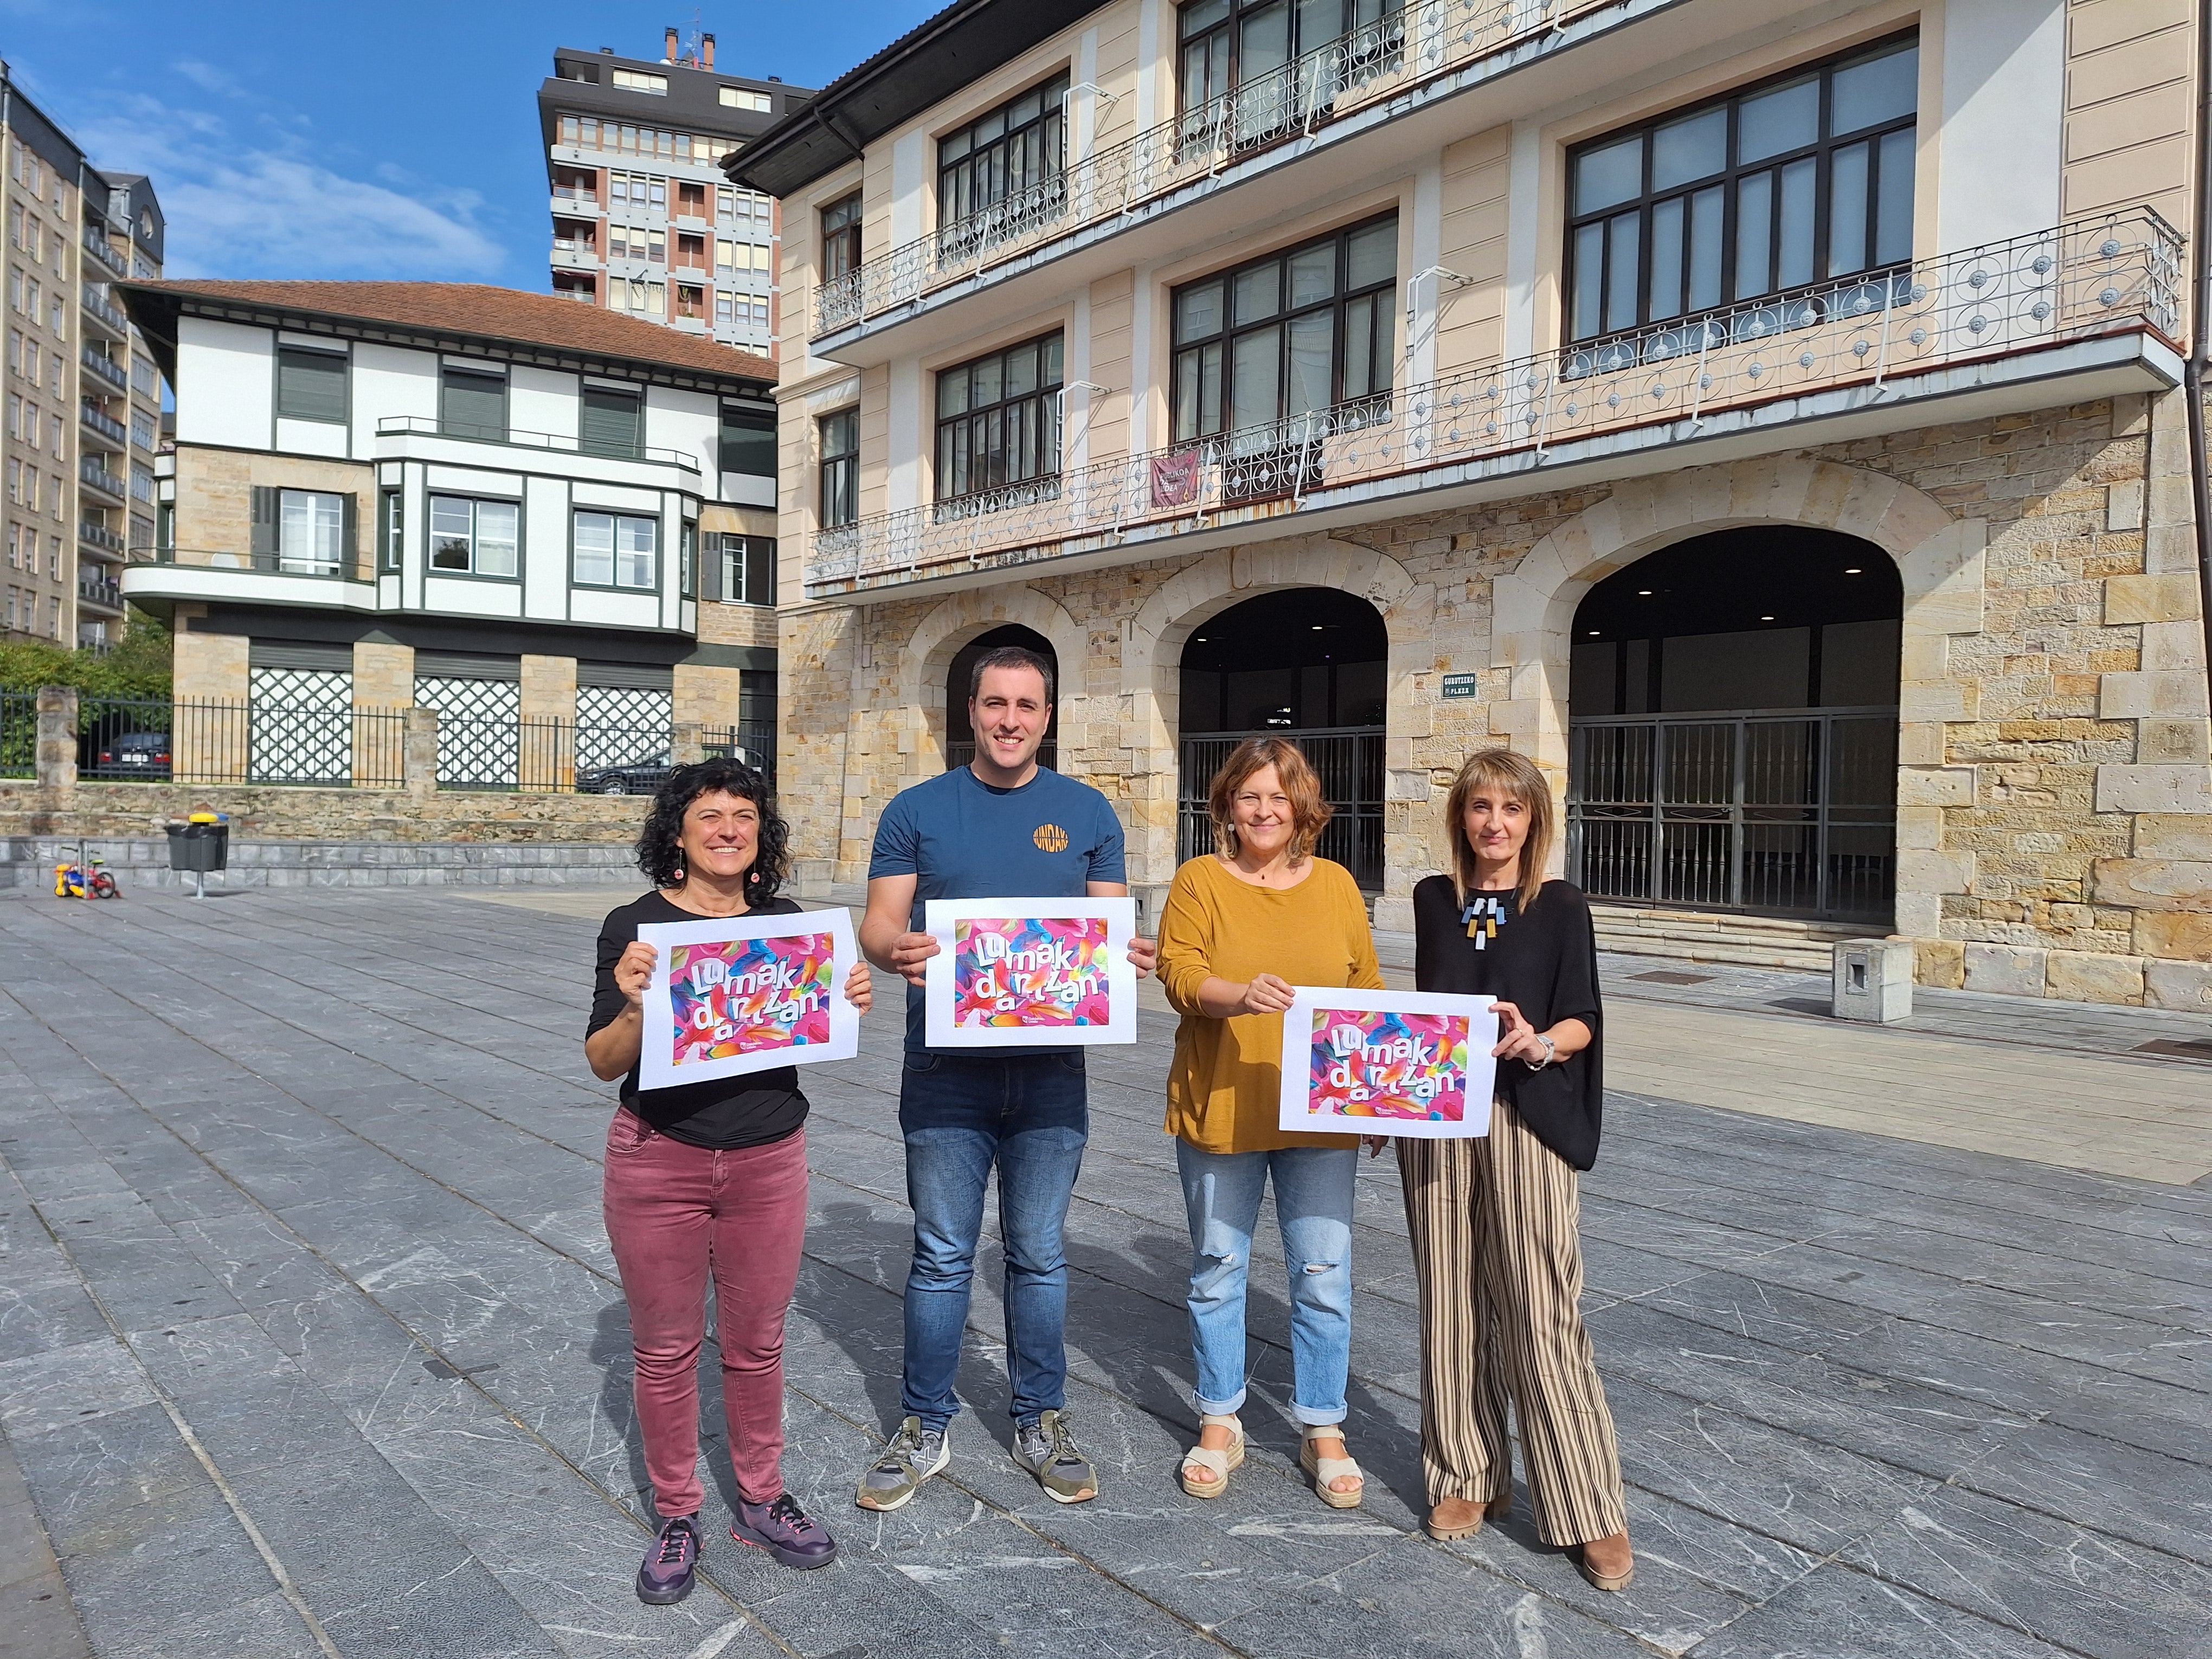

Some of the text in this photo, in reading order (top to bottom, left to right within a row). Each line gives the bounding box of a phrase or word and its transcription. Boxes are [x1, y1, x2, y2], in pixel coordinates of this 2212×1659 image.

[1444, 676, 1474, 685] GURUTZEKO
[975, 937, 1074, 971] Lumak
[691, 960, 800, 996] Lumak
[1331, 1028, 1432, 1067] Lumak
